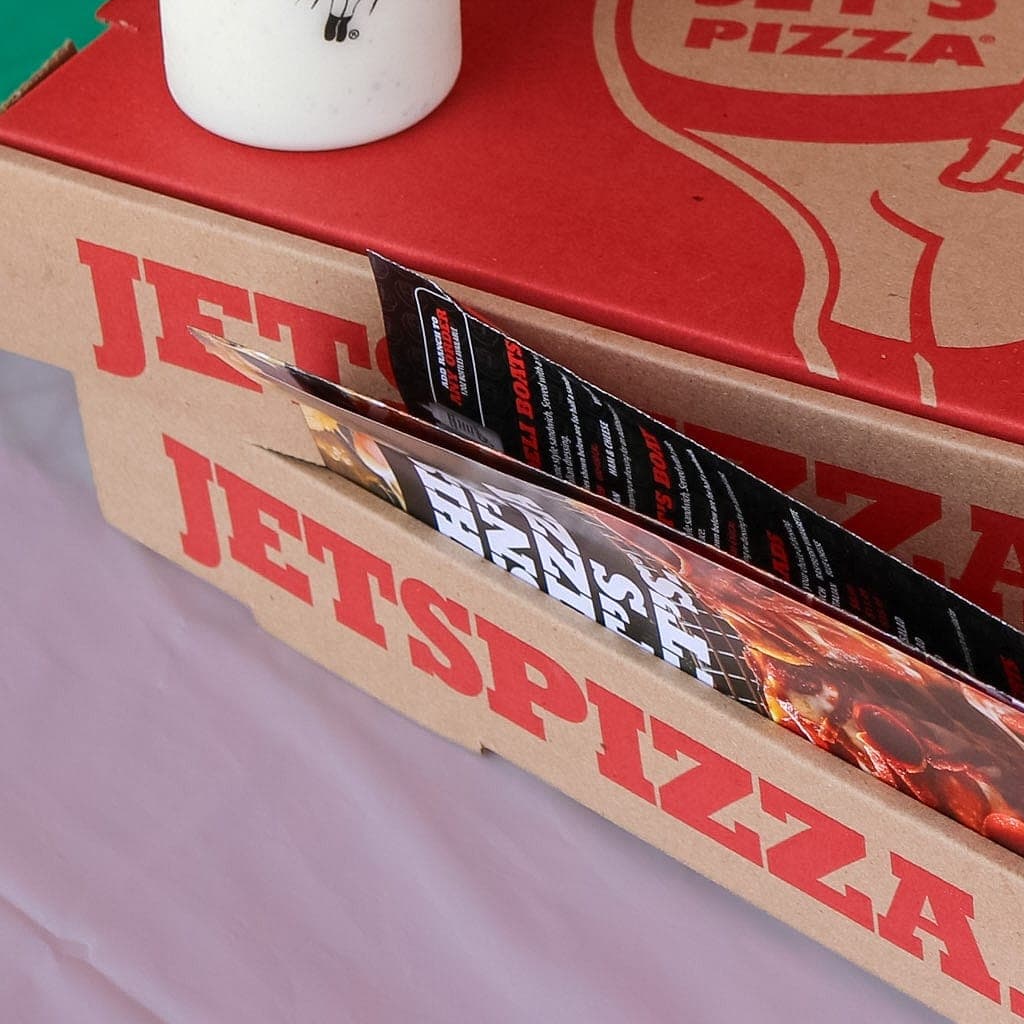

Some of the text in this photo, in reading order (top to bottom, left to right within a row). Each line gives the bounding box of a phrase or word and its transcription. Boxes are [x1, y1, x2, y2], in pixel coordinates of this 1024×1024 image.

[684, 17, 986, 68] PIZZA
[431, 316, 449, 390] ADD RANCH TO
[435, 308, 456, 367] ORDER
[504, 338, 534, 420] BOATS
[537, 383, 551, 409] Served
[599, 419, 613, 449] CHEESE
[640, 427, 673, 489] BOAT
[607, 457, 618, 476] HAM
